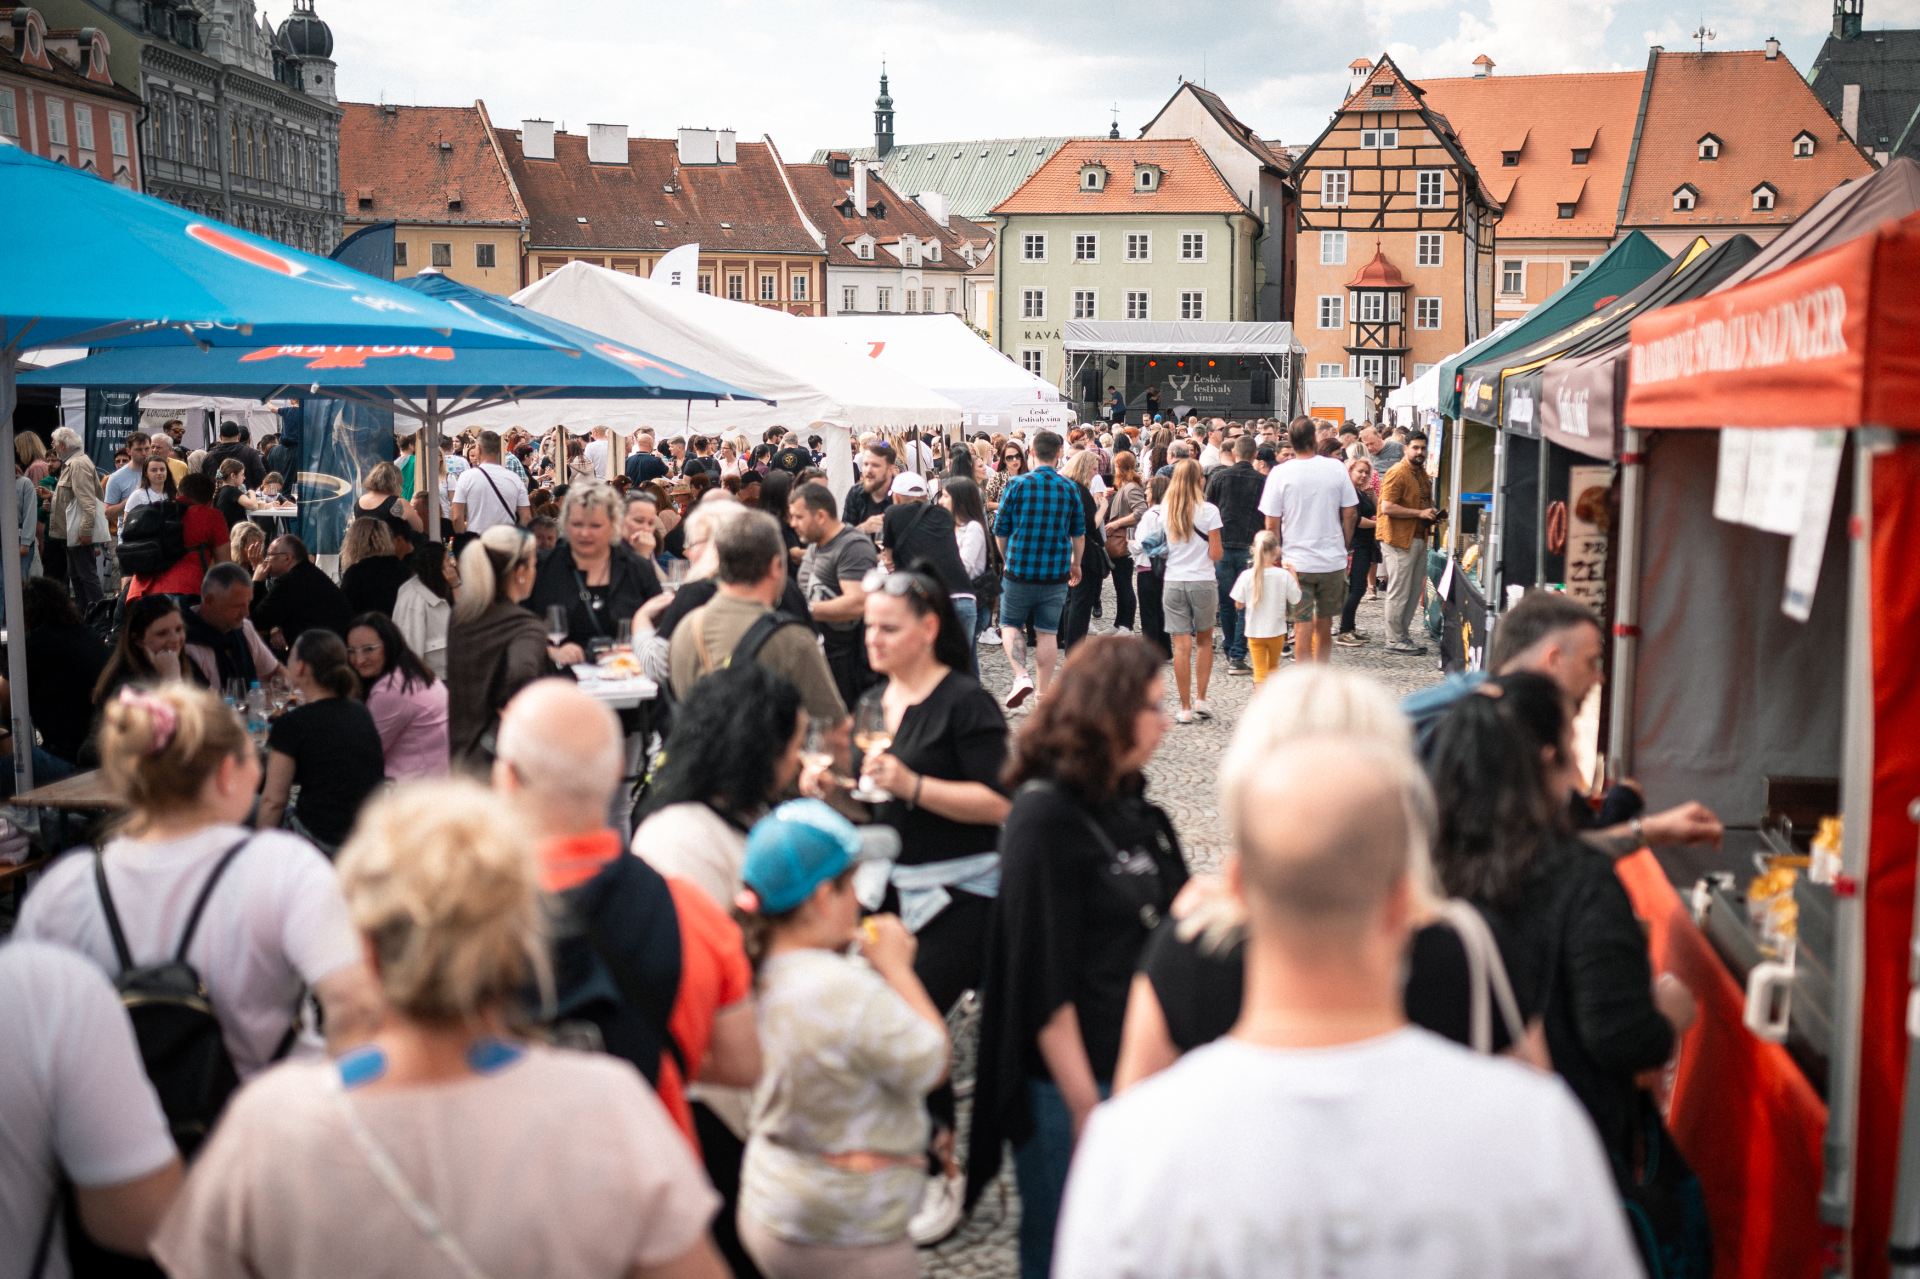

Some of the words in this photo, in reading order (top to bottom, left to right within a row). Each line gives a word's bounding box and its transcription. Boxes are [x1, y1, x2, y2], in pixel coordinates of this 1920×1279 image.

[1024, 328, 1061, 340] KAVÁ
[1193, 372, 1221, 383] České
[1193, 383, 1231, 396] festivaly
[1193, 393, 1214, 402] vína
[1029, 407, 1049, 416] České
[1018, 416, 1045, 424] festivaly
